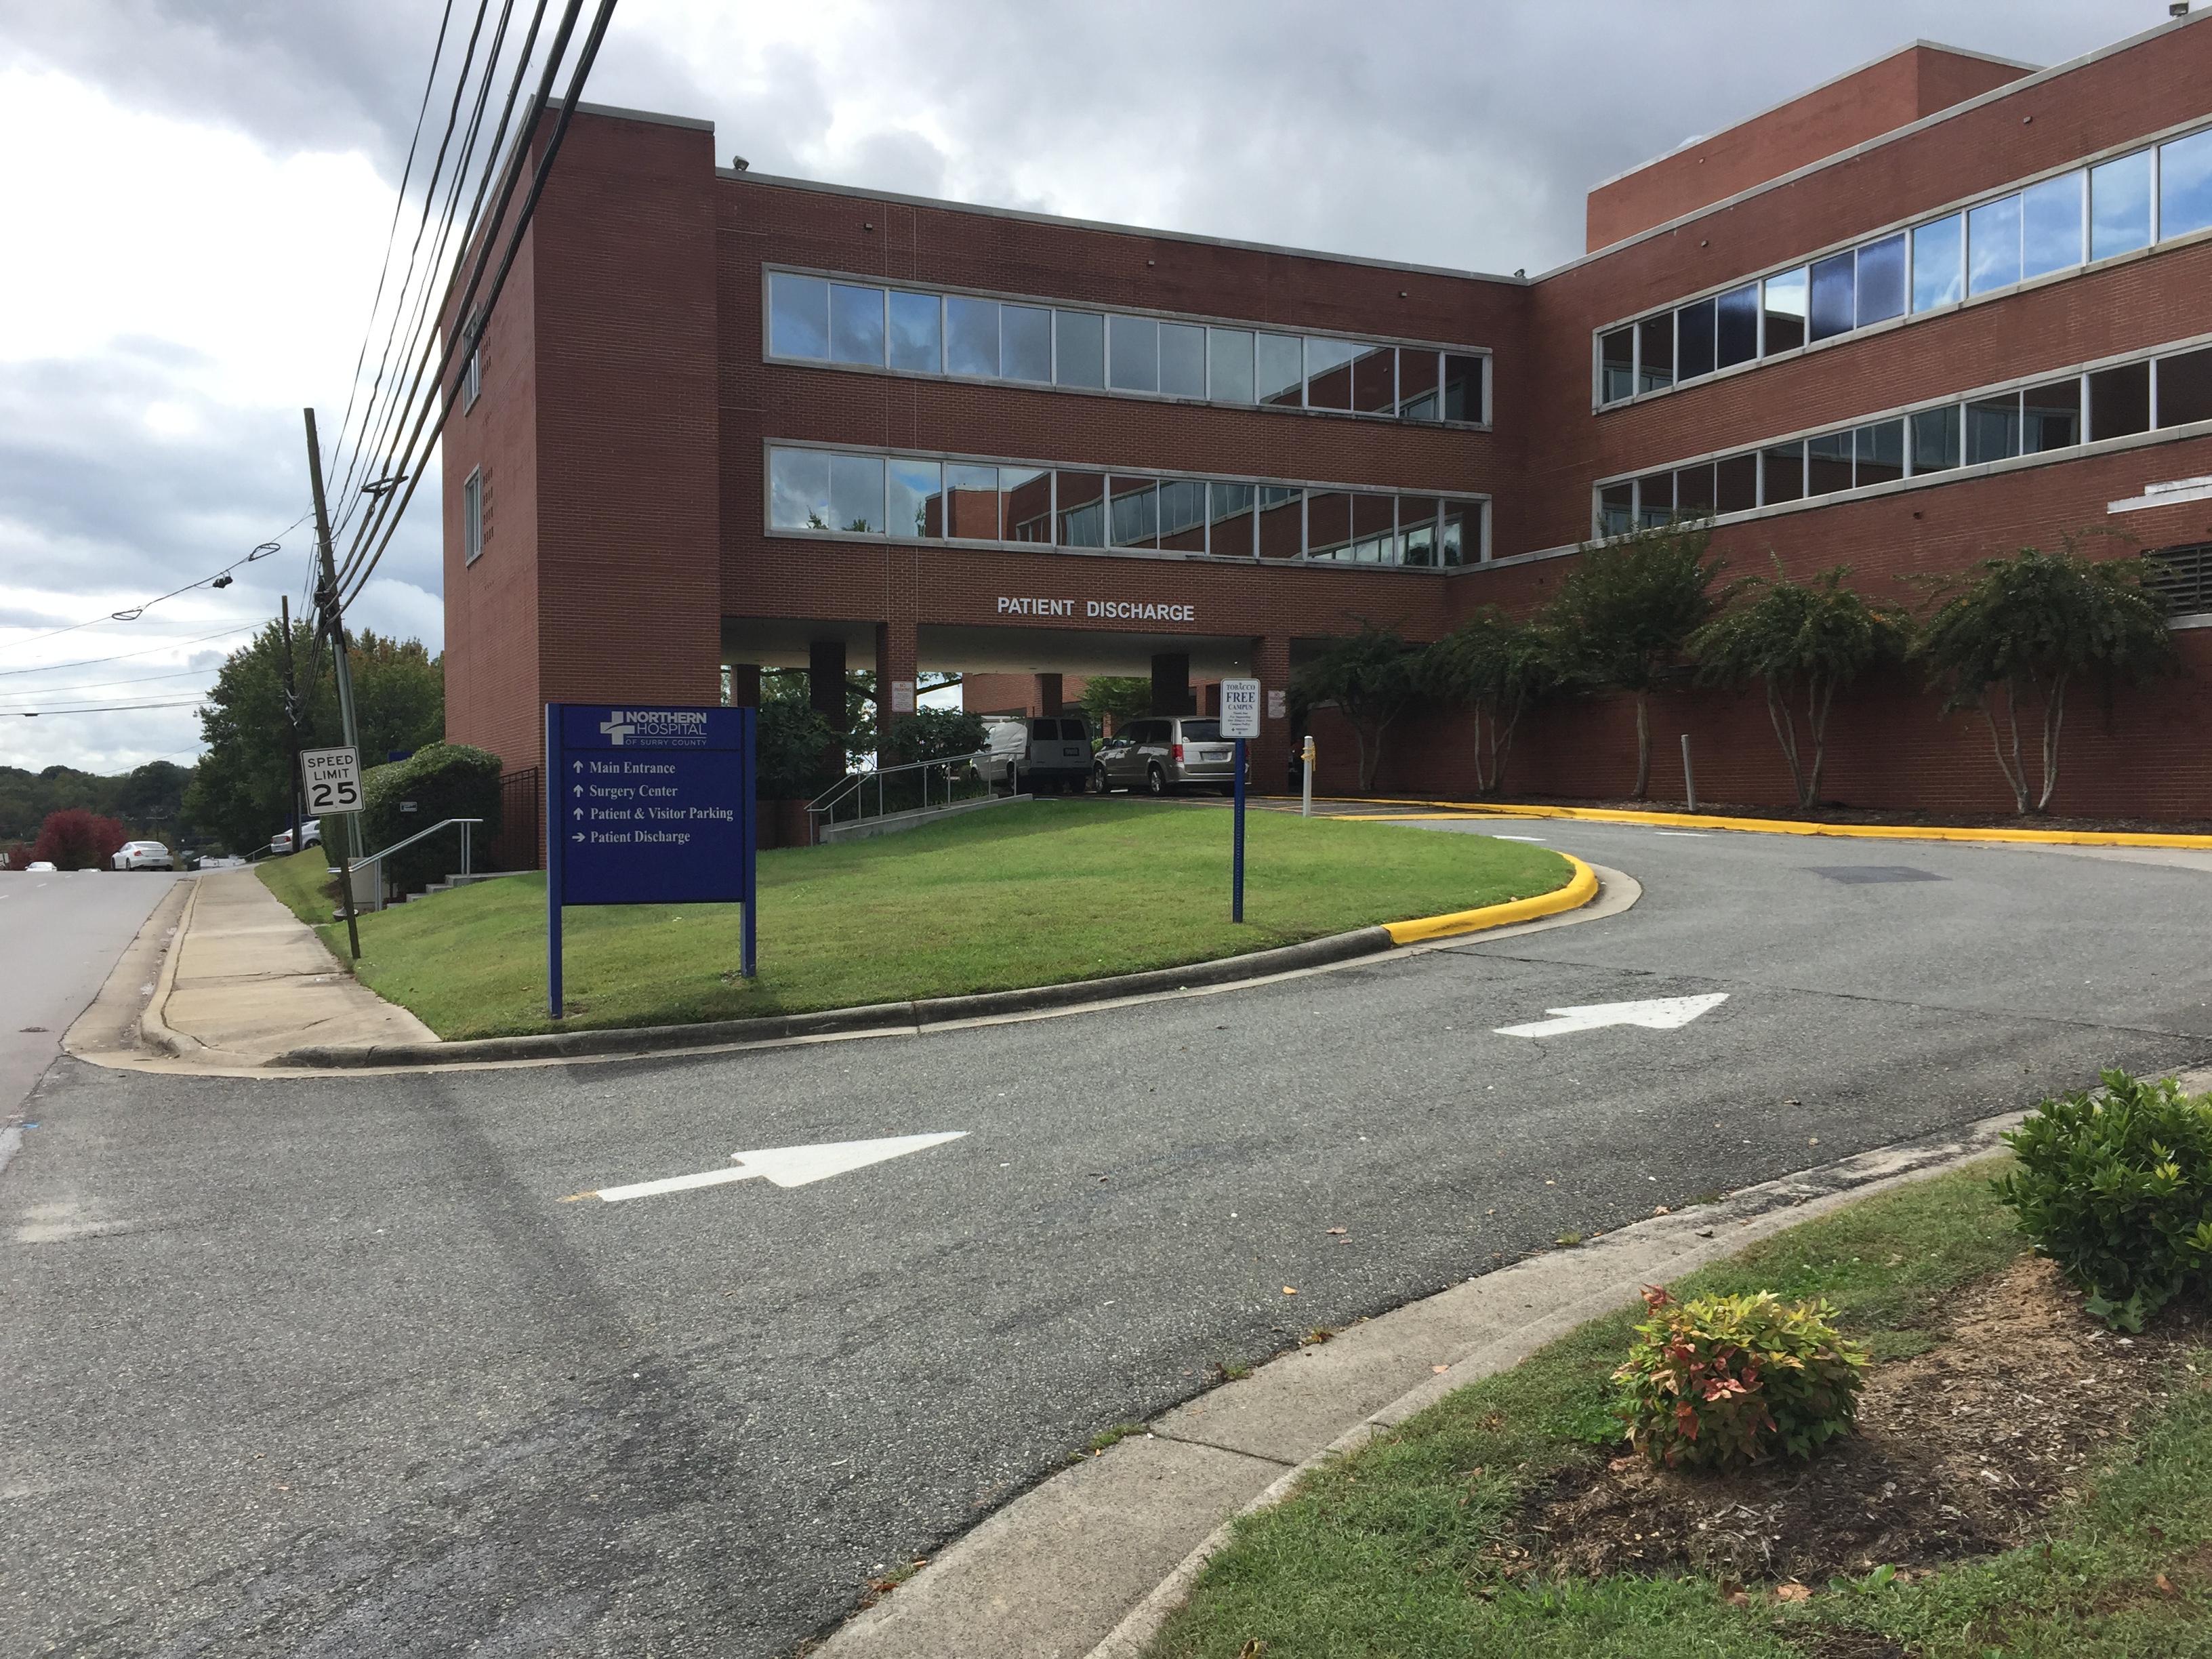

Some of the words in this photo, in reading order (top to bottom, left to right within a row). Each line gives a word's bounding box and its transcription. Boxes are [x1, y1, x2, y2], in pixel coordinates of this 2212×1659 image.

[998, 597, 1075, 616] PATIENT
[1087, 601, 1195, 621] DISCHARGE
[1226, 692, 1255, 702] FREE
[626, 712, 707, 723] NORTHERN
[637, 723, 707, 735] HOSPITAL
[308, 755, 353, 768] SPEED
[590, 762, 620, 773] Main
[623, 762, 676, 774] Entrance
[314, 769, 350, 781] LIMIT
[312, 781, 357, 806] 25
[590, 785, 636, 800] Surgery
[638, 785, 678, 797] Center
[590, 808, 632, 820] Patient
[634, 808, 645, 819] &
[649, 808, 687, 819] Visitor
[689, 807, 734, 821] Parking
[590, 831, 632, 843] Patient
[634, 831, 691, 845] Discharge
